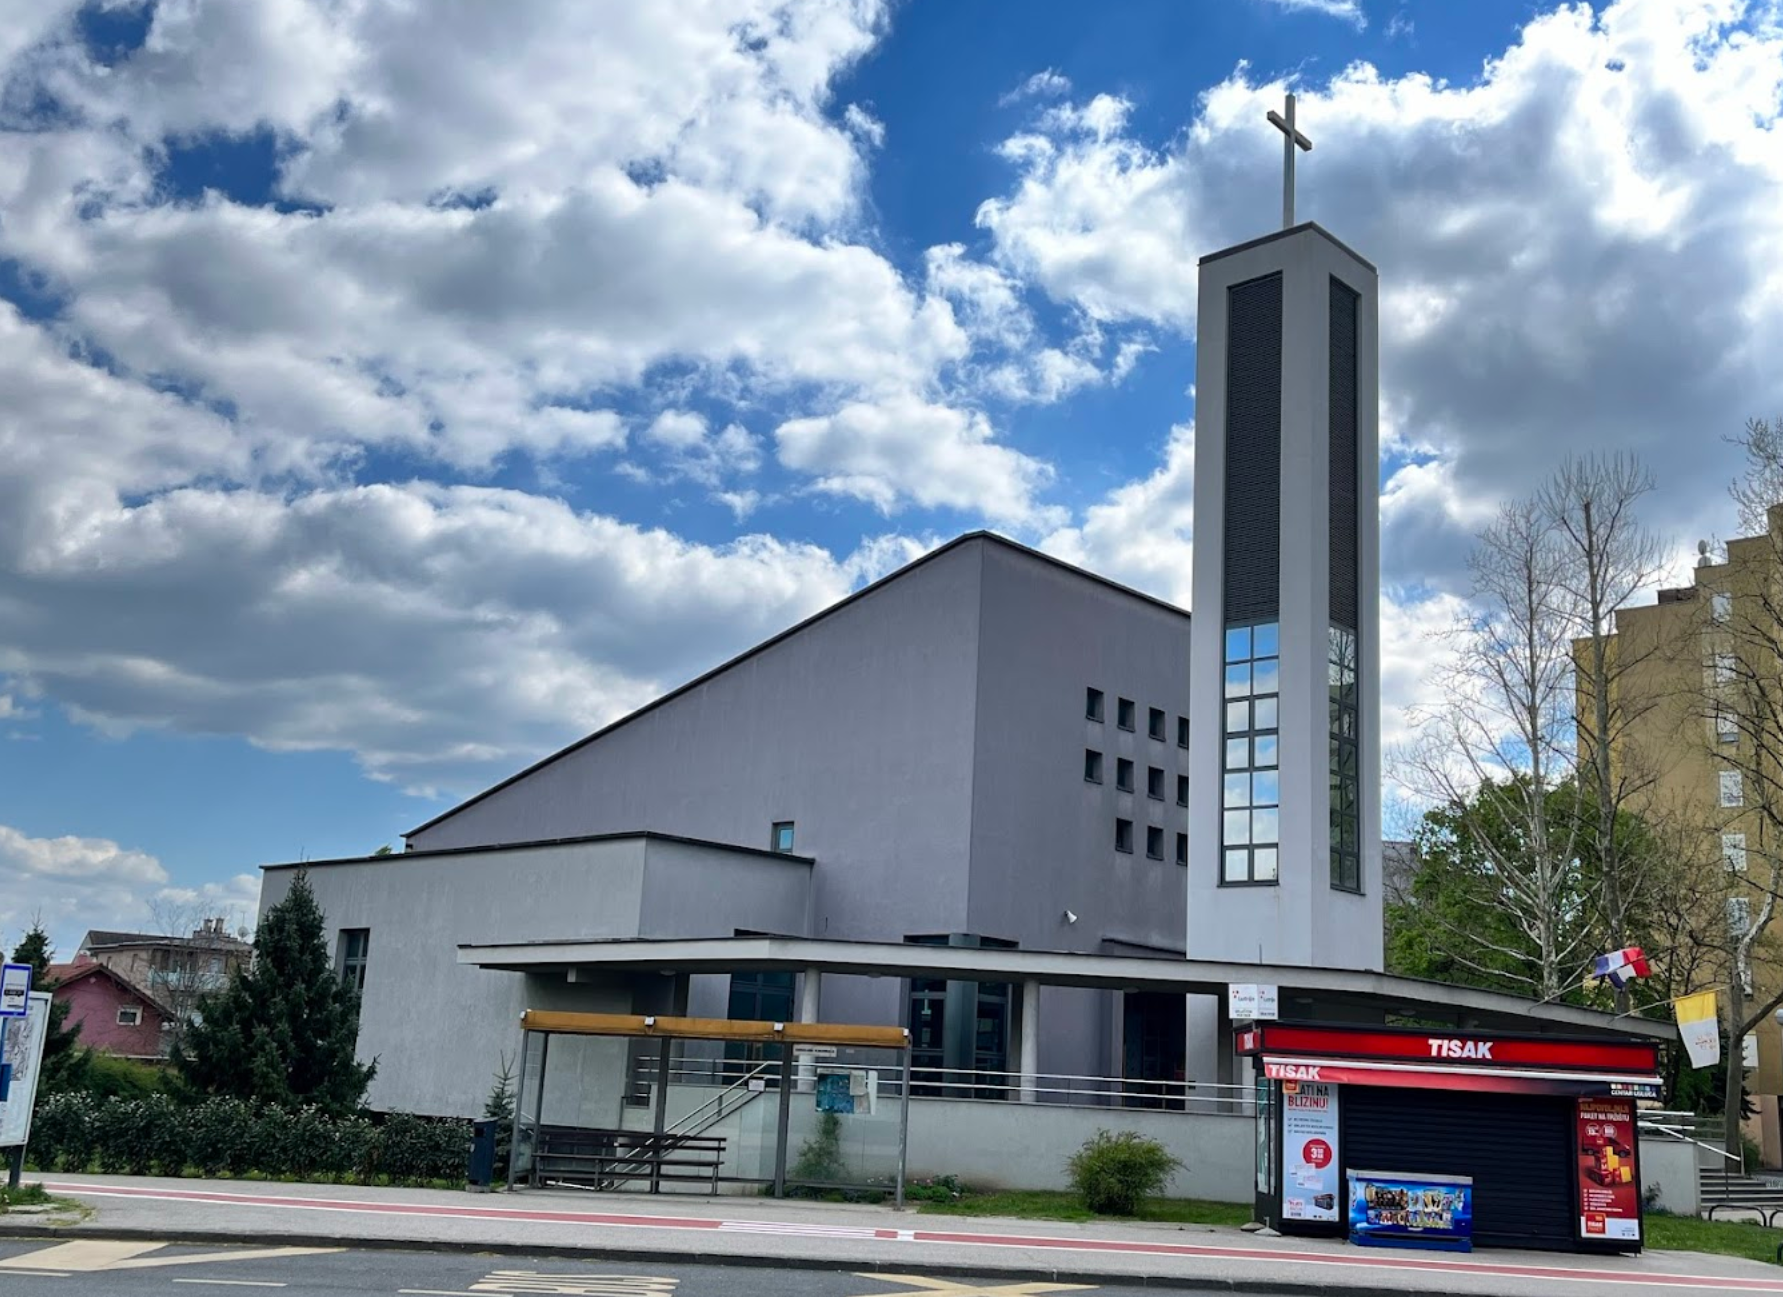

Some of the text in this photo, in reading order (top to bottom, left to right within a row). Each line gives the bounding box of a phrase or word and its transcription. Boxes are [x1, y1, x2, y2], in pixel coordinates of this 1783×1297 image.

[1428, 1038, 1494, 1059] TISAK
[1268, 1063, 1321, 1080] TISAK
[1317, 1084, 1330, 1097] NA
[1288, 1095, 1329, 1109] BLIZINU!
